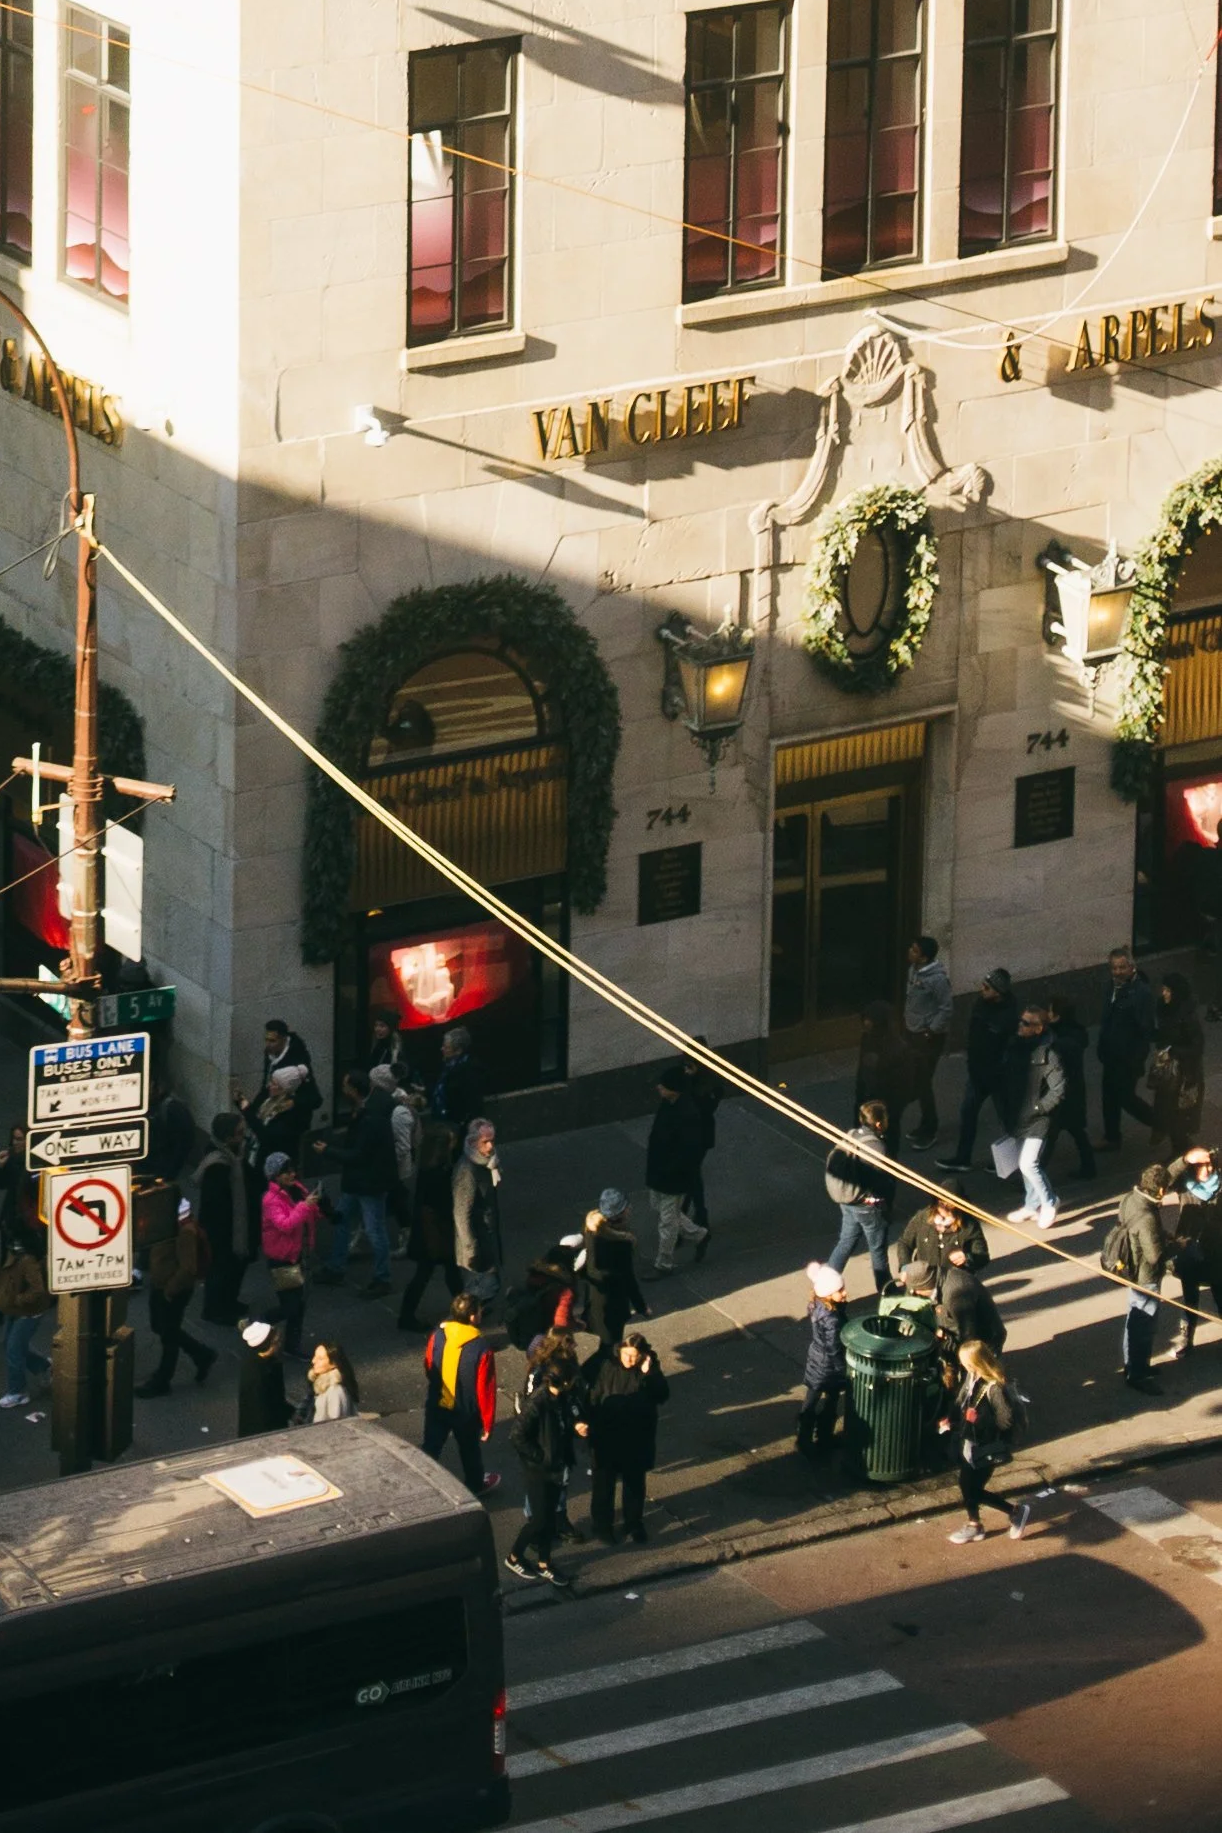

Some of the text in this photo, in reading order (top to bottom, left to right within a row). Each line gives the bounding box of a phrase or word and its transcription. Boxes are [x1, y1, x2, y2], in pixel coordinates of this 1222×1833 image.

[532, 295, 1216, 461] VAN CLEEF & ARPELS
[1026, 728, 1069, 755] 744
[646, 803, 691, 830] 744
[129, 996, 140, 1020] 5
[65, 1040, 136, 1060] BUS LANE
[43, 1054, 135, 1078] BUSES ONLY
[44, 1133, 136, 1157] ONE WAY
[56, 1253, 125, 1272] 7AM-7PM
[57, 1269, 124, 1285] EXCEPT BUSES
[357, 1686, 382, 1704] GO
